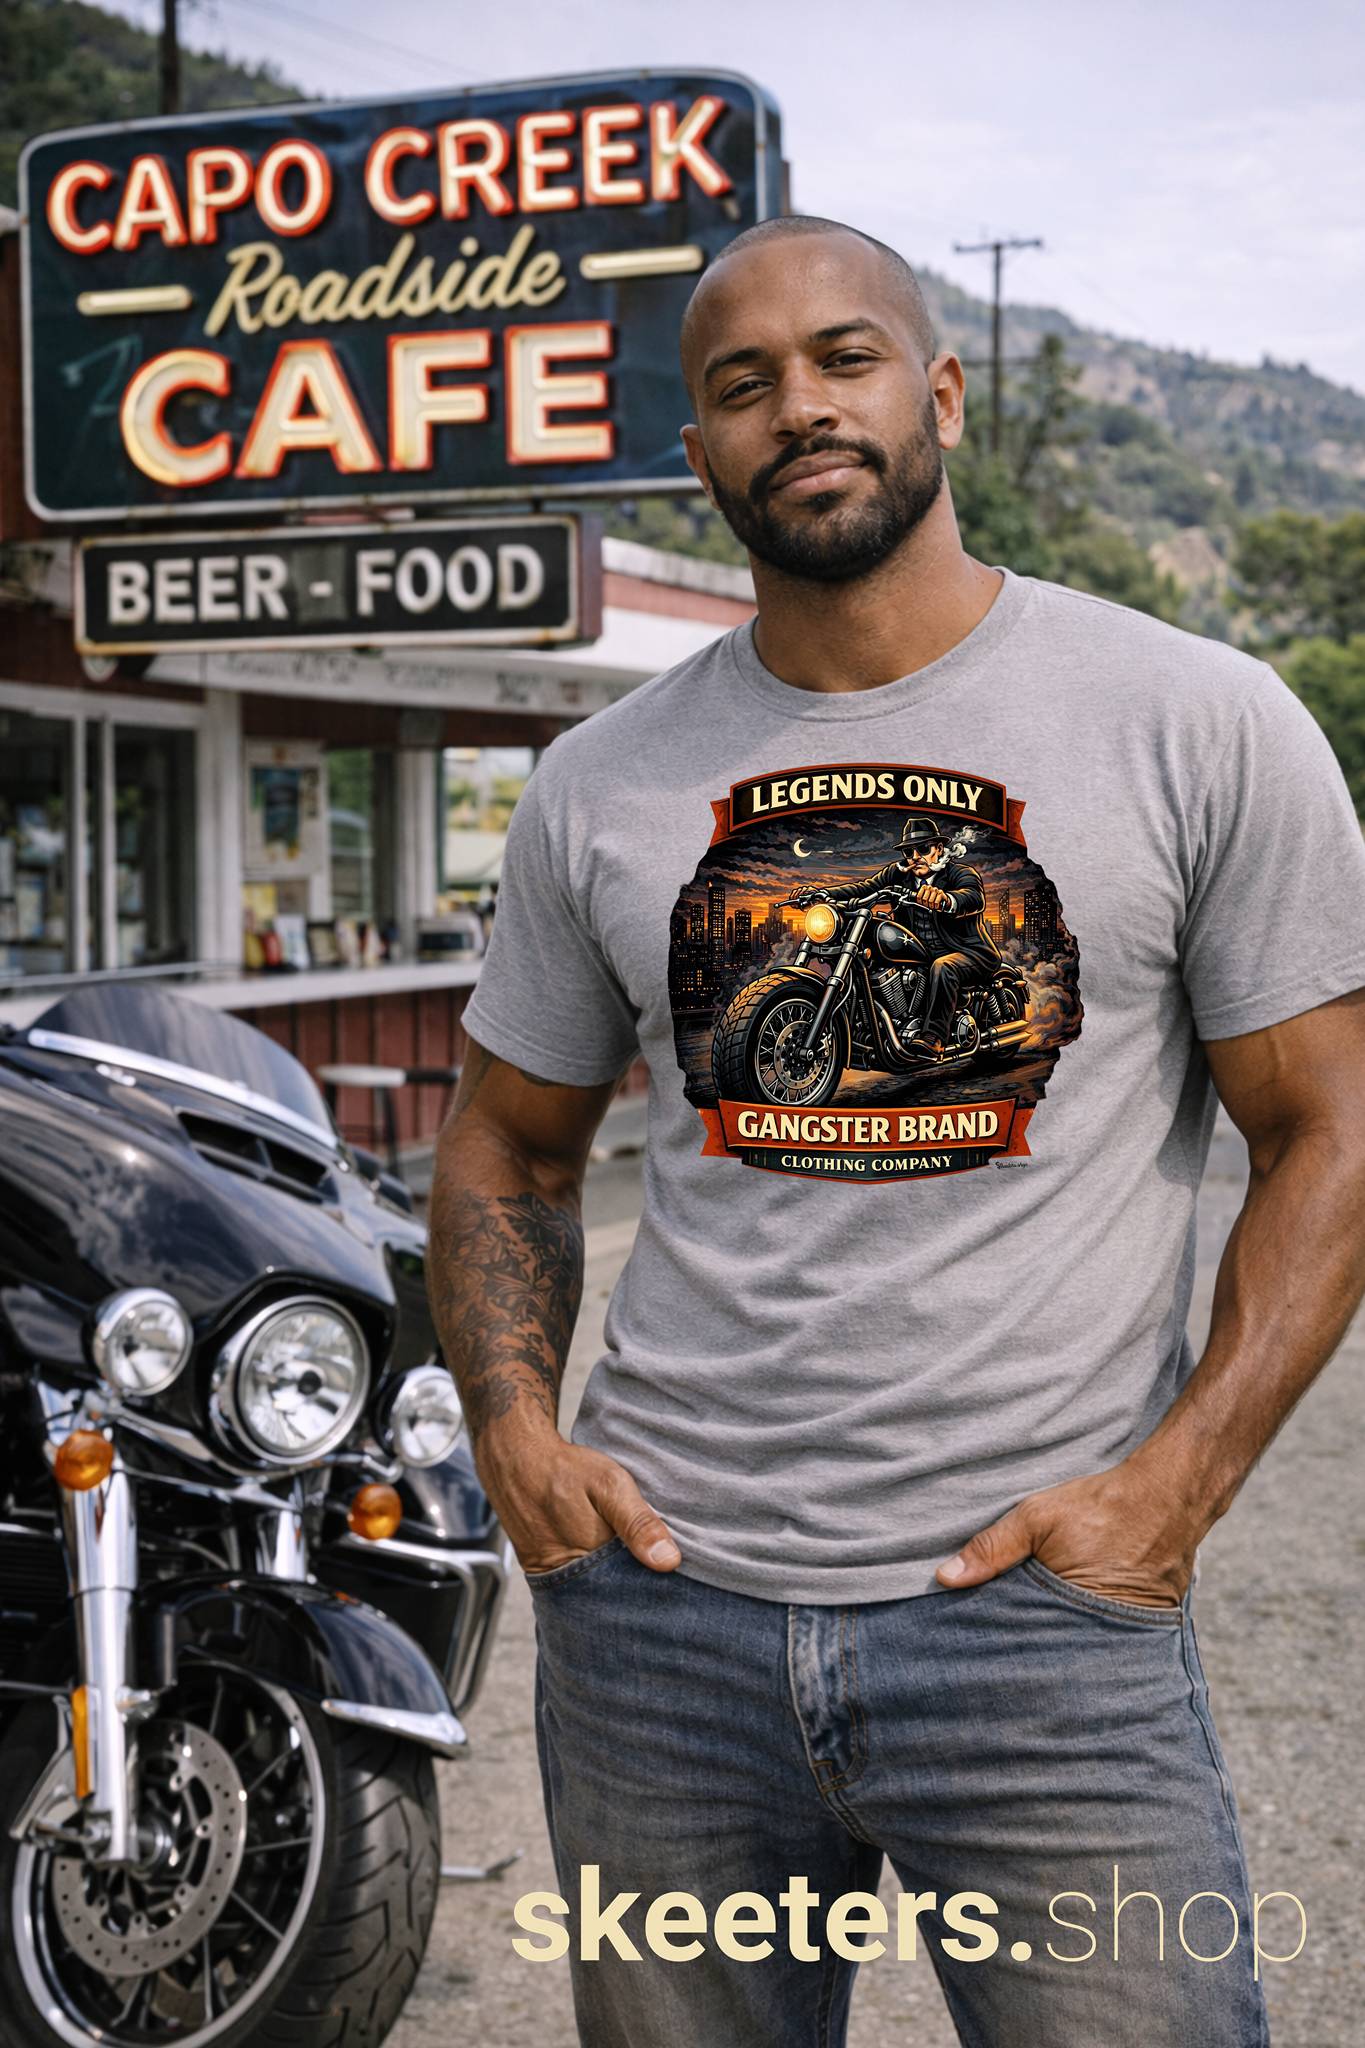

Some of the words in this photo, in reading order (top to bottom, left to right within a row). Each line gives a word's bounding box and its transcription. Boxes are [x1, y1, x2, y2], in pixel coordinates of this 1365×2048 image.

[46, 138, 332, 255] CAPO
[365, 95, 734, 225] CREEK
[205, 226, 566, 336] Roadside
[120, 320, 615, 488] CAFE
[106, 553, 290, 626] BEER
[356, 545, 545, 616] FOOD
[752, 773, 895, 813] LEGENDS
[904, 775, 984, 812] ONLY
[737, 1110, 889, 1143] GANGSTER
[898, 1110, 999, 1142] BRAND
[781, 1155, 866, 1172] CLOTHING
[871, 1155, 953, 1172] COMPANY
